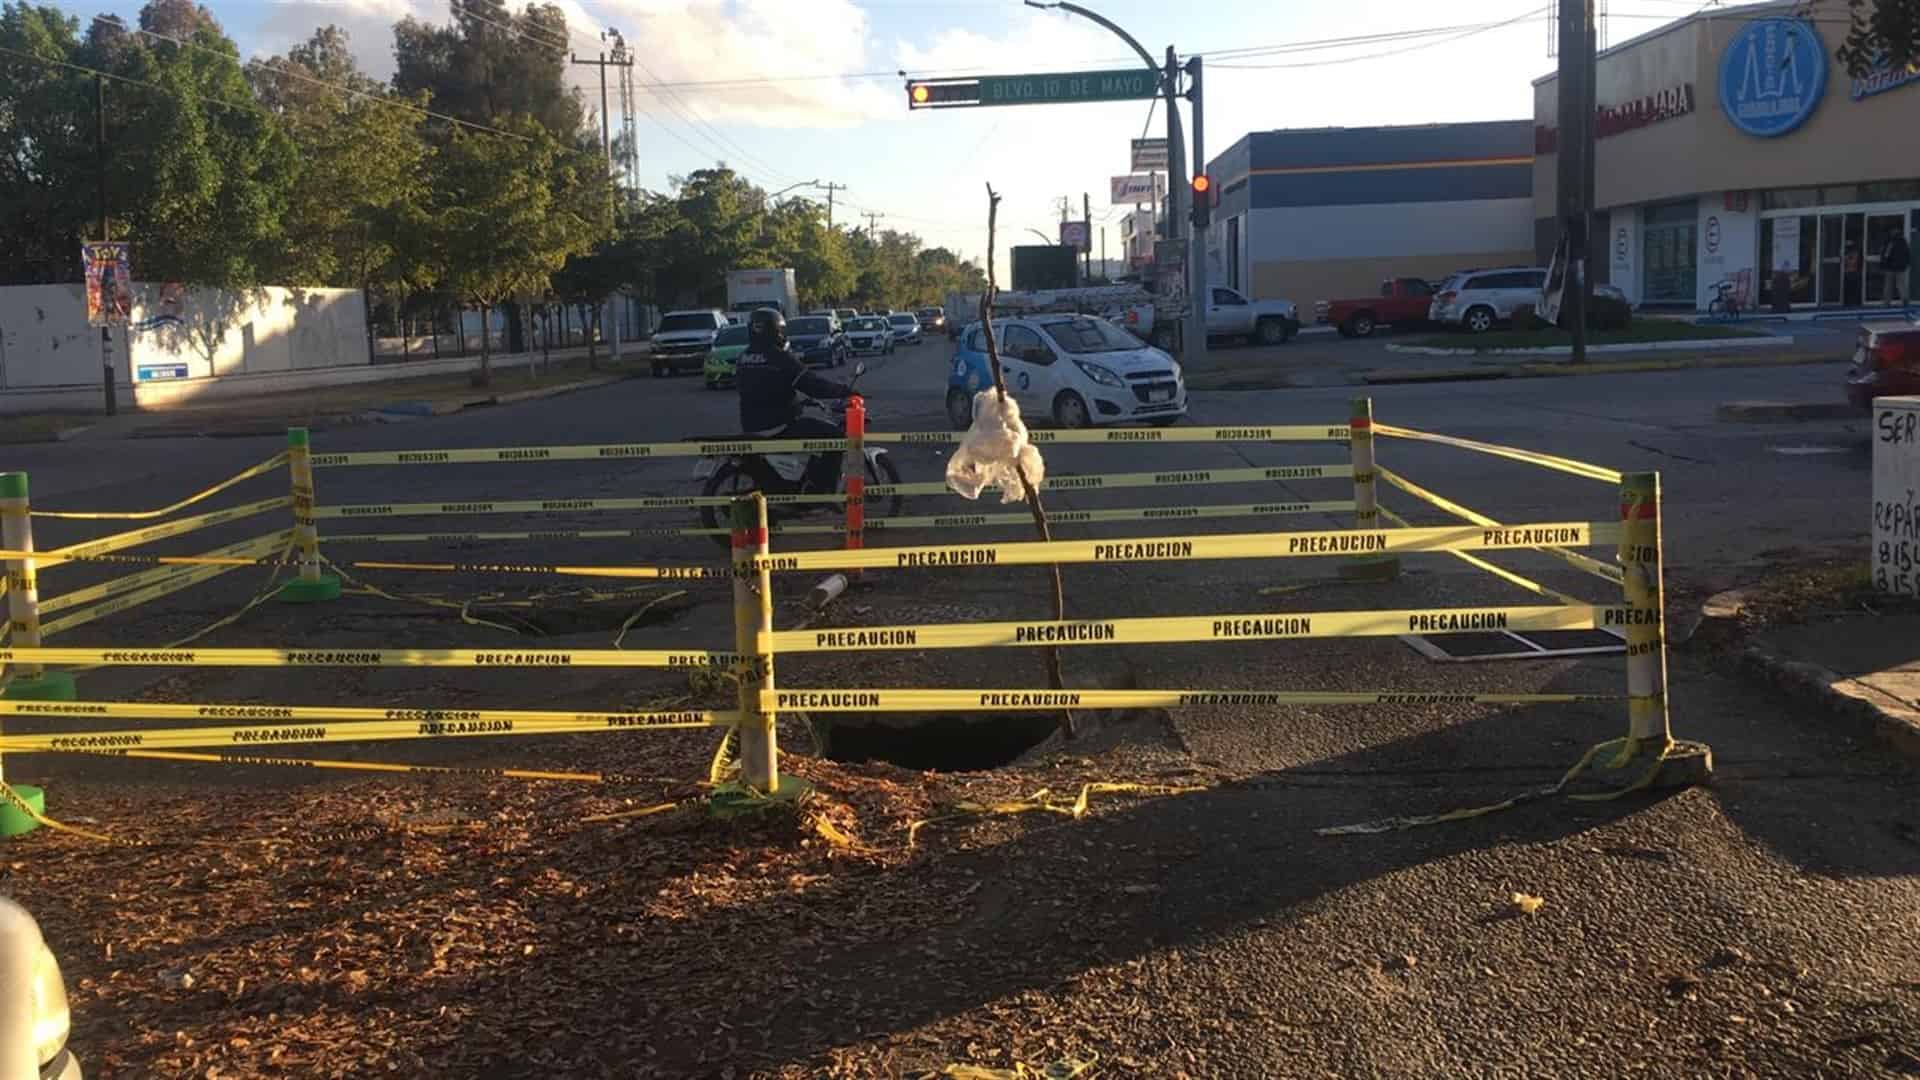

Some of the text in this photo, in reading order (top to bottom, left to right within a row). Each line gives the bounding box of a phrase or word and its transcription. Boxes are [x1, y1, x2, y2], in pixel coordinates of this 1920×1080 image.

[1043, 79, 1061, 97] 10
[1070, 78, 1089, 96] DE
[1101, 76, 1144, 95] MAYO
[897, 549, 997, 567] PRECAUCION
[1095, 541, 1193, 560] PRECAUCION
[1289, 534, 1387, 554] PRECAUCION
[1483, 528, 1581, 546] PRECAUCION
[817, 630, 917, 648] PRECAUCION
[1016, 624, 1115, 643] PRECAUCION
[1213, 617, 1311, 637] PRECAUCION
[1408, 612, 1507, 631] PRECAUCION
[103, 652, 196, 663] PRECAUCION
[287, 652, 382, 664] PRECAUCION
[474, 653, 571, 666] PRECAUCION
[778, 693, 880, 709] PRECAUCION
[980, 693, 1081, 707] PRECAUCION
[232, 727, 327, 743] PRECAUCION
[417, 720, 513, 735] PRECAUCION
[607, 712, 704, 727] PRECAUCION
